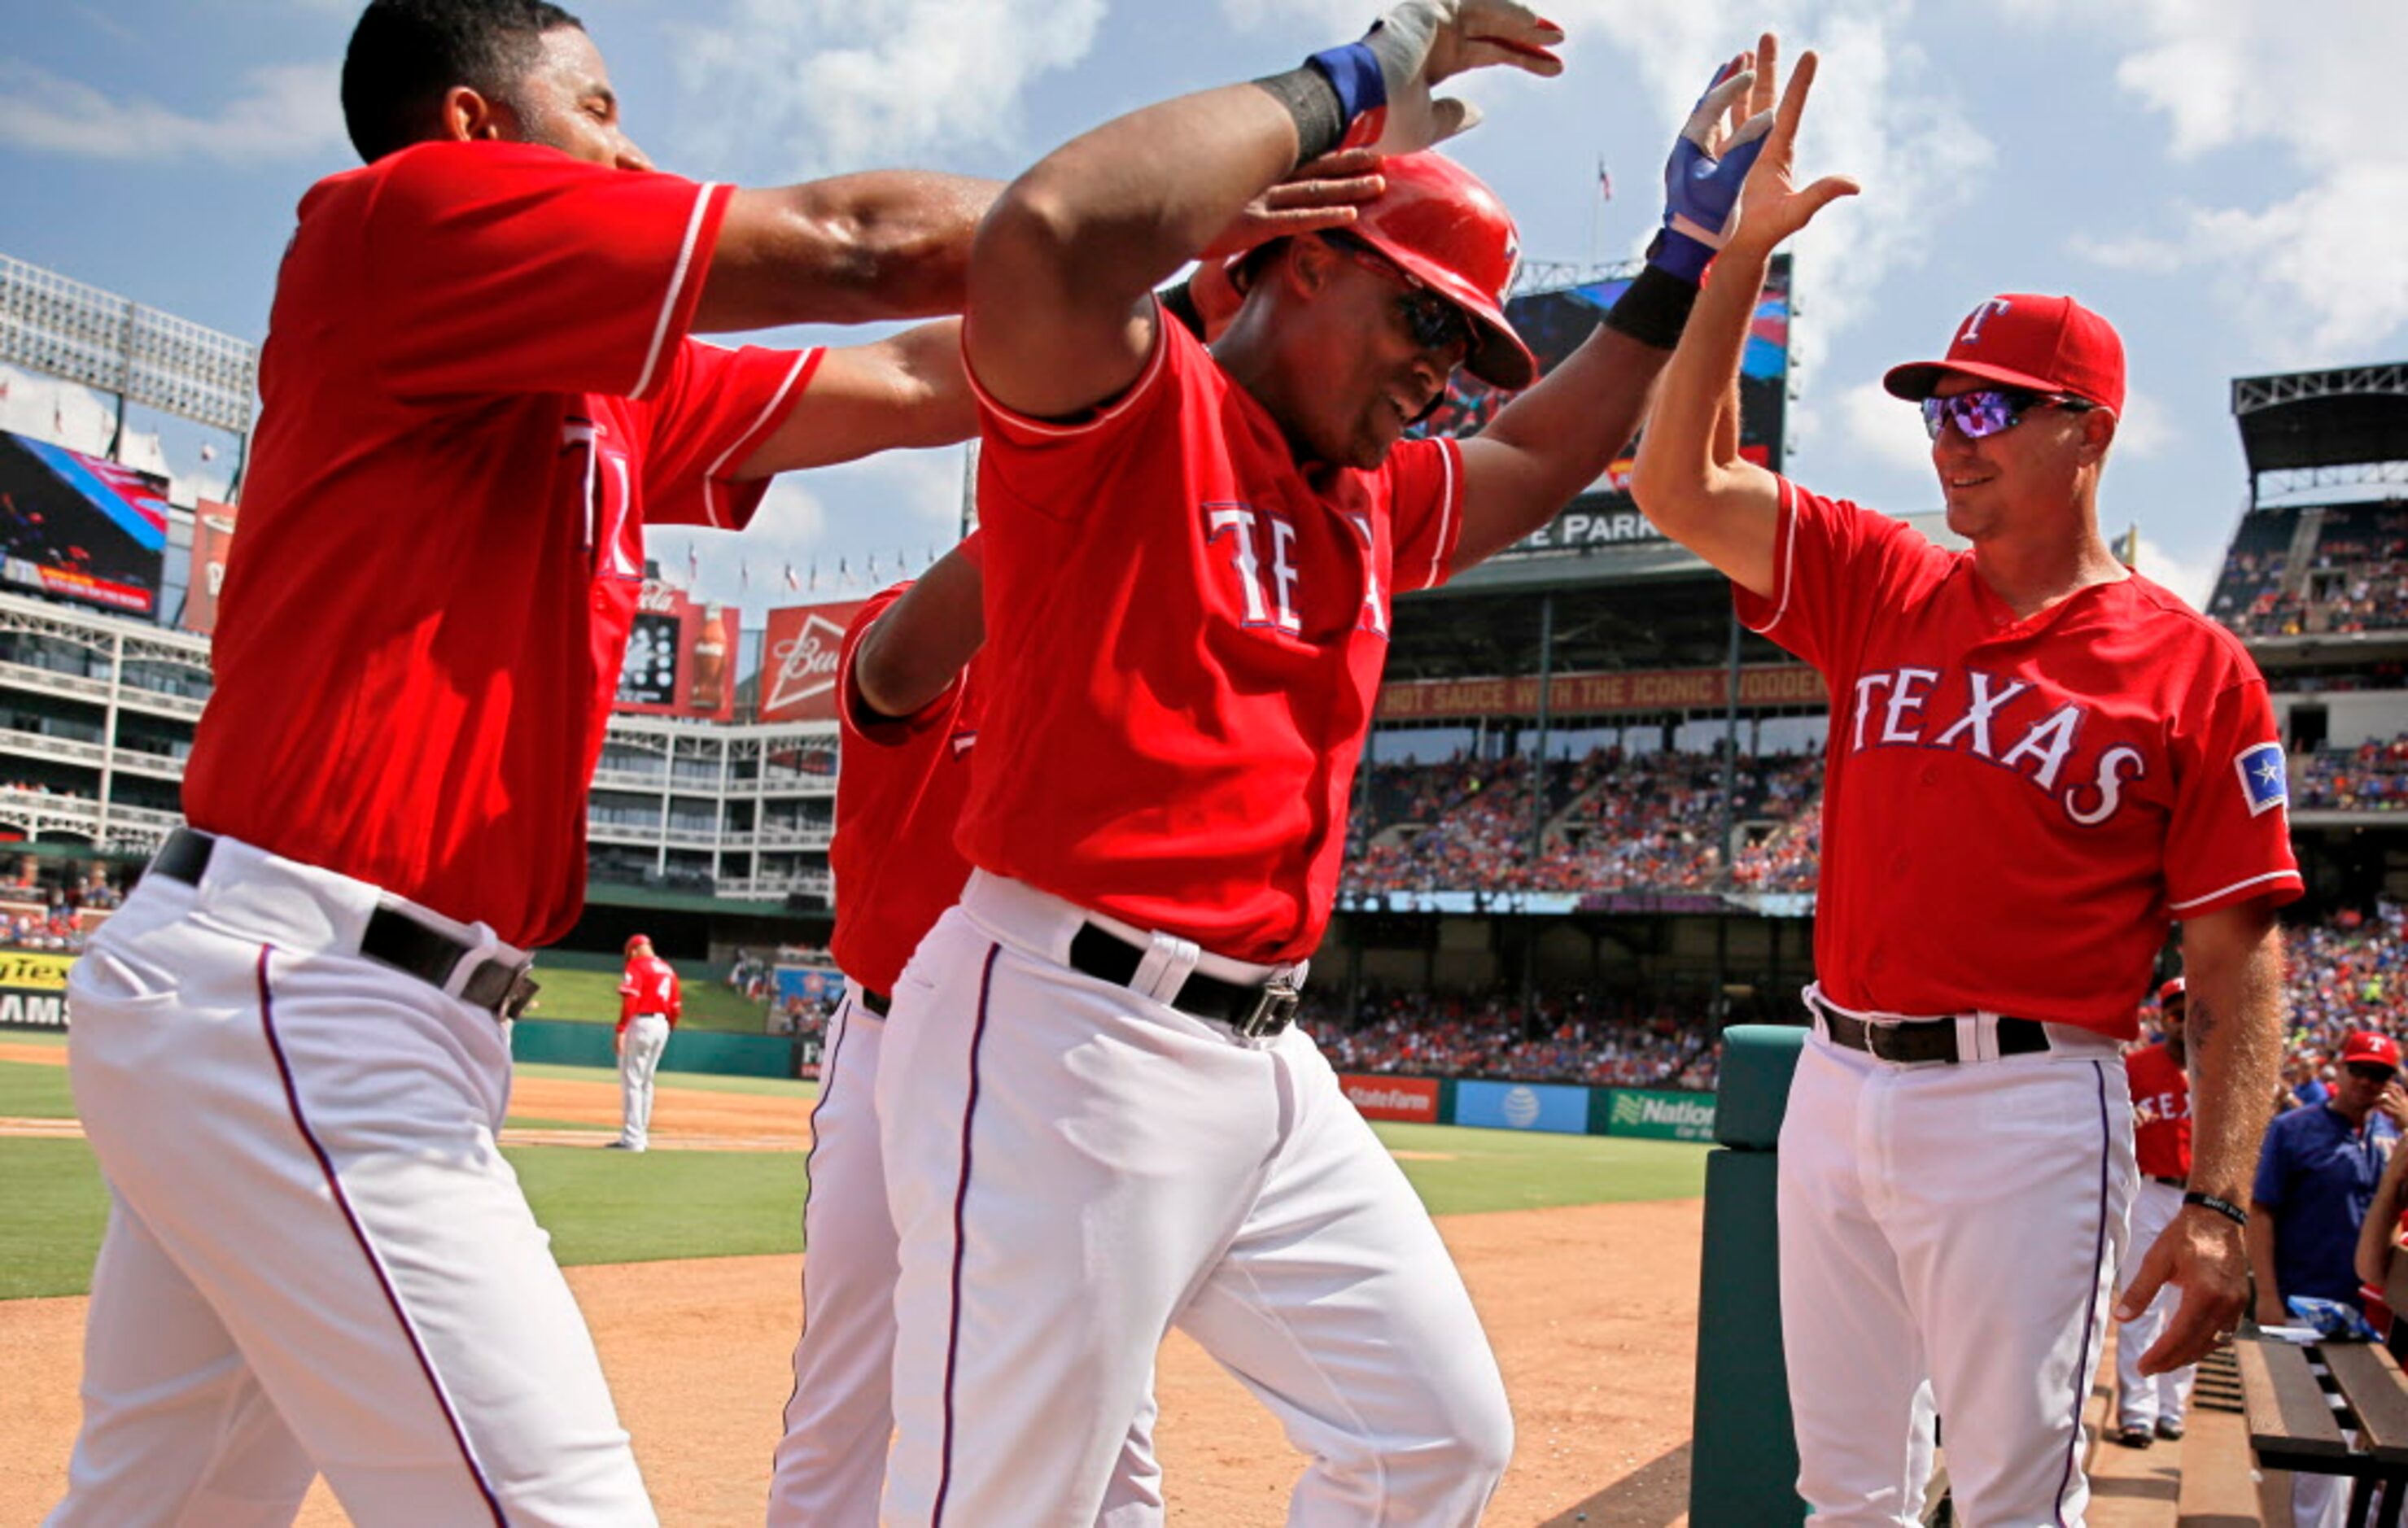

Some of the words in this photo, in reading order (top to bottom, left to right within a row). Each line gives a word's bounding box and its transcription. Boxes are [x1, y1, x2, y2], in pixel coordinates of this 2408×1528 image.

[1961, 298, 2012, 344] T
[1385, 685, 1423, 713] HOT
[1433, 682, 1505, 710] SAUCE
[1514, 679, 1571, 707] WTH
[1583, 676, 1624, 705] THE
[1633, 674, 1713, 702] ICONIC
[1852, 667, 2146, 827] TEXAS
[2367, 1036, 2387, 1052] T
